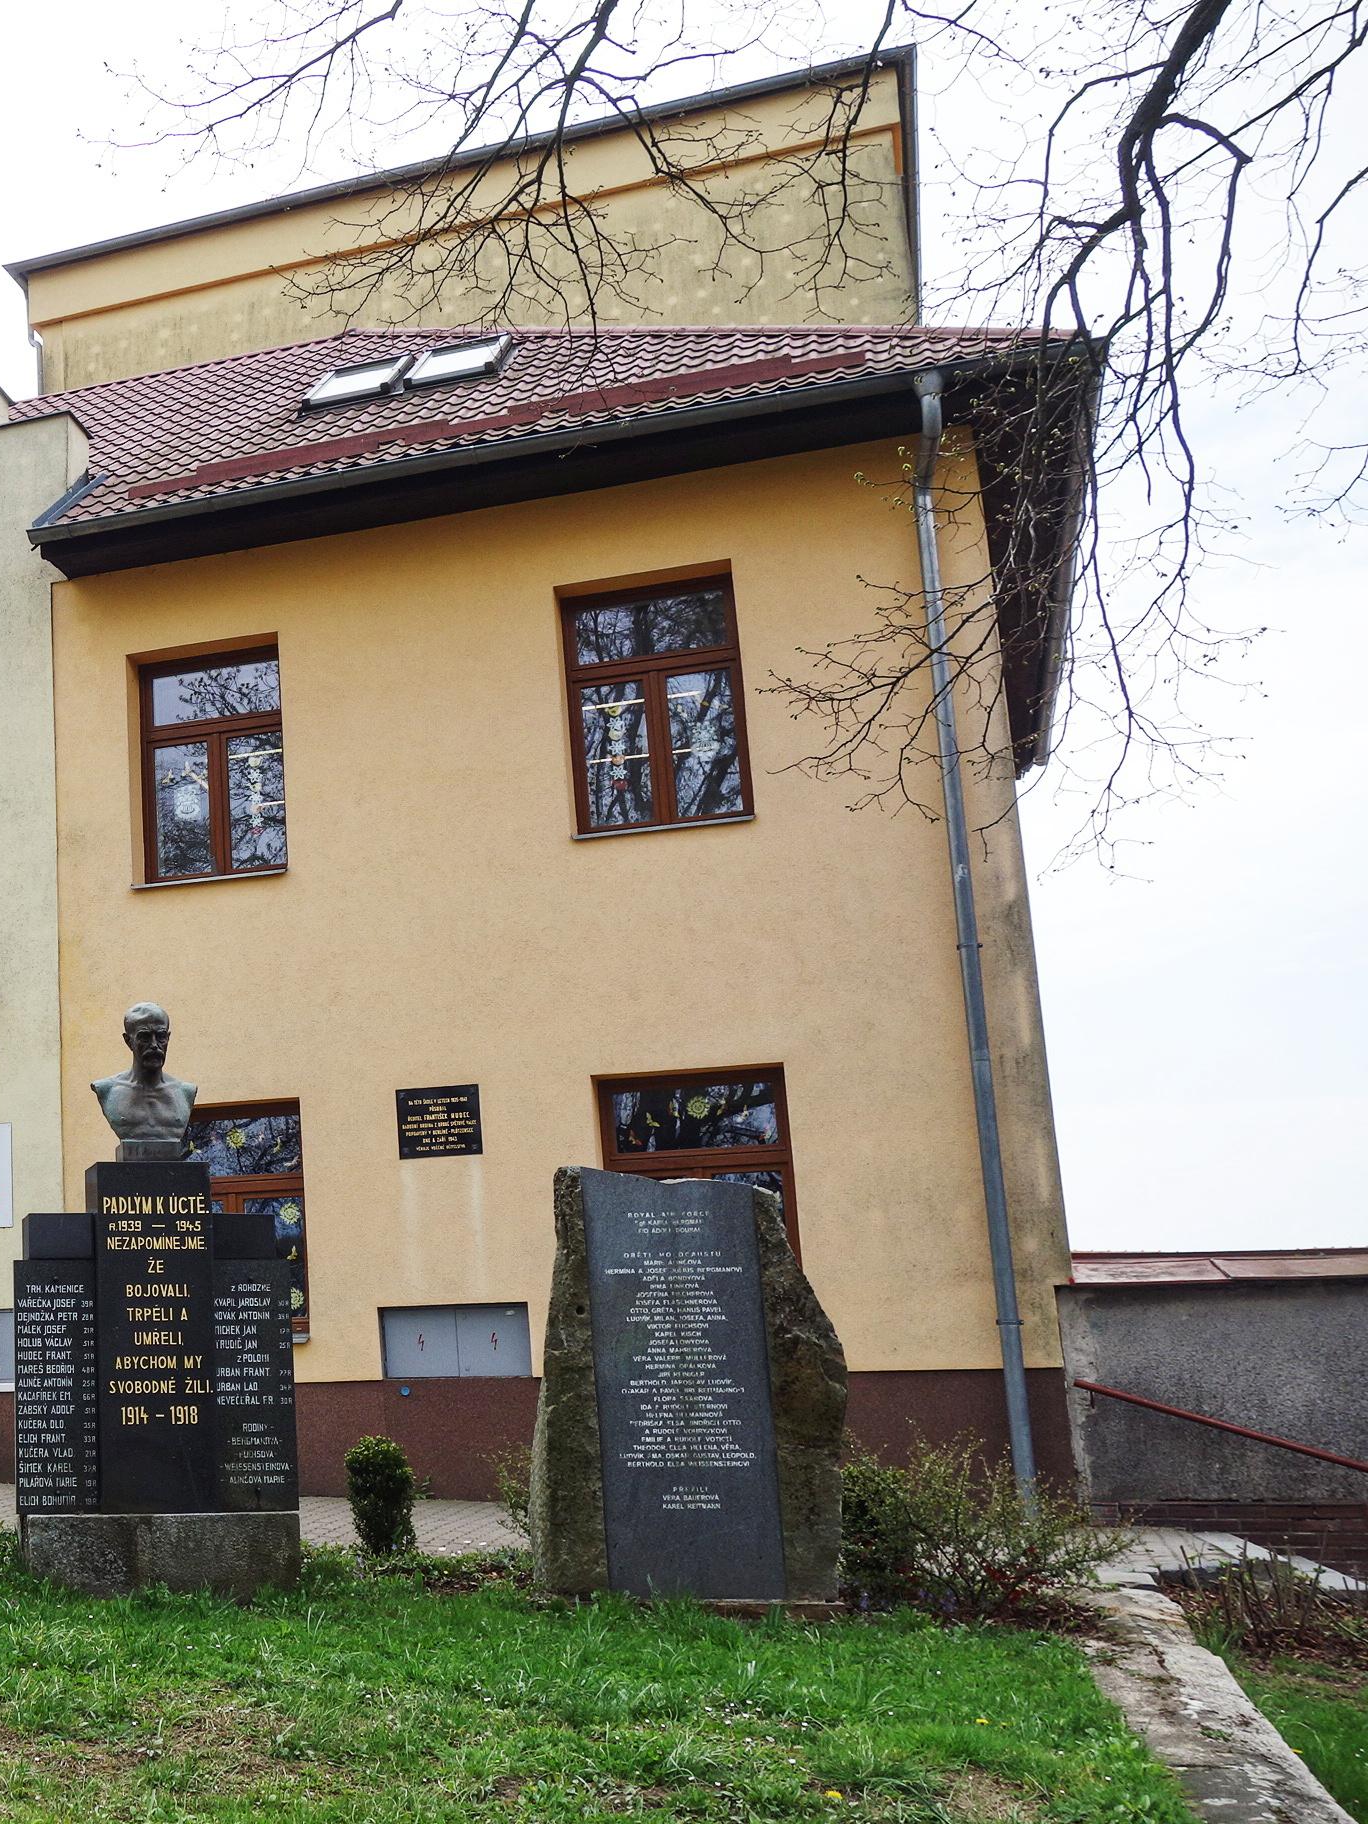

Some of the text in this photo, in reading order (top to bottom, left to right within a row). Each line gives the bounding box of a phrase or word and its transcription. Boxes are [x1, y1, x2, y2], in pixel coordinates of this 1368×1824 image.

[103, 1193, 209, 1214] PADLÝM K ÚCTĚ.
[176, 1220, 201, 1231] 1945
[147, 1257, 164, 1273] ŽE
[45, 1285, 84, 1293] KAMENICE
[17, 1296, 51, 1307] VAŘEČKA
[52, 1299, 76, 1310] JOSEF
[238, 1298, 271, 1308] JAROSLAV
[58, 1312, 77, 1321] PETR
[180, 1308, 188, 1321] A
[18, 1322, 41, 1334] MÁLEK
[43, 1325, 66, 1335] JOSEF
[242, 1325, 256, 1336] JAN
[18, 1338, 42, 1347] HOLUB
[45, 1336, 72, 1347] VÁCLAV
[244, 1340, 257, 1351] JAN
[18, 1351, 42, 1360] HUDEC
[18, 1363, 43, 1374] MAREŠ
[116, 1356, 202, 1370] ABYCHOM MY
[43, 1376, 73, 1387] ANTONÍN
[185, 1376, 213, 1394] ŽILI.
[51, 1405, 75, 1414] ADOLF
[121, 1406, 149, 1425] 1914
[170, 1406, 198, 1425] 1918
[18, 1418, 47, 1429] KUČERA
[19, 1446, 49, 1457] KUČERA
[47, 1463, 73, 1472] KAREL
